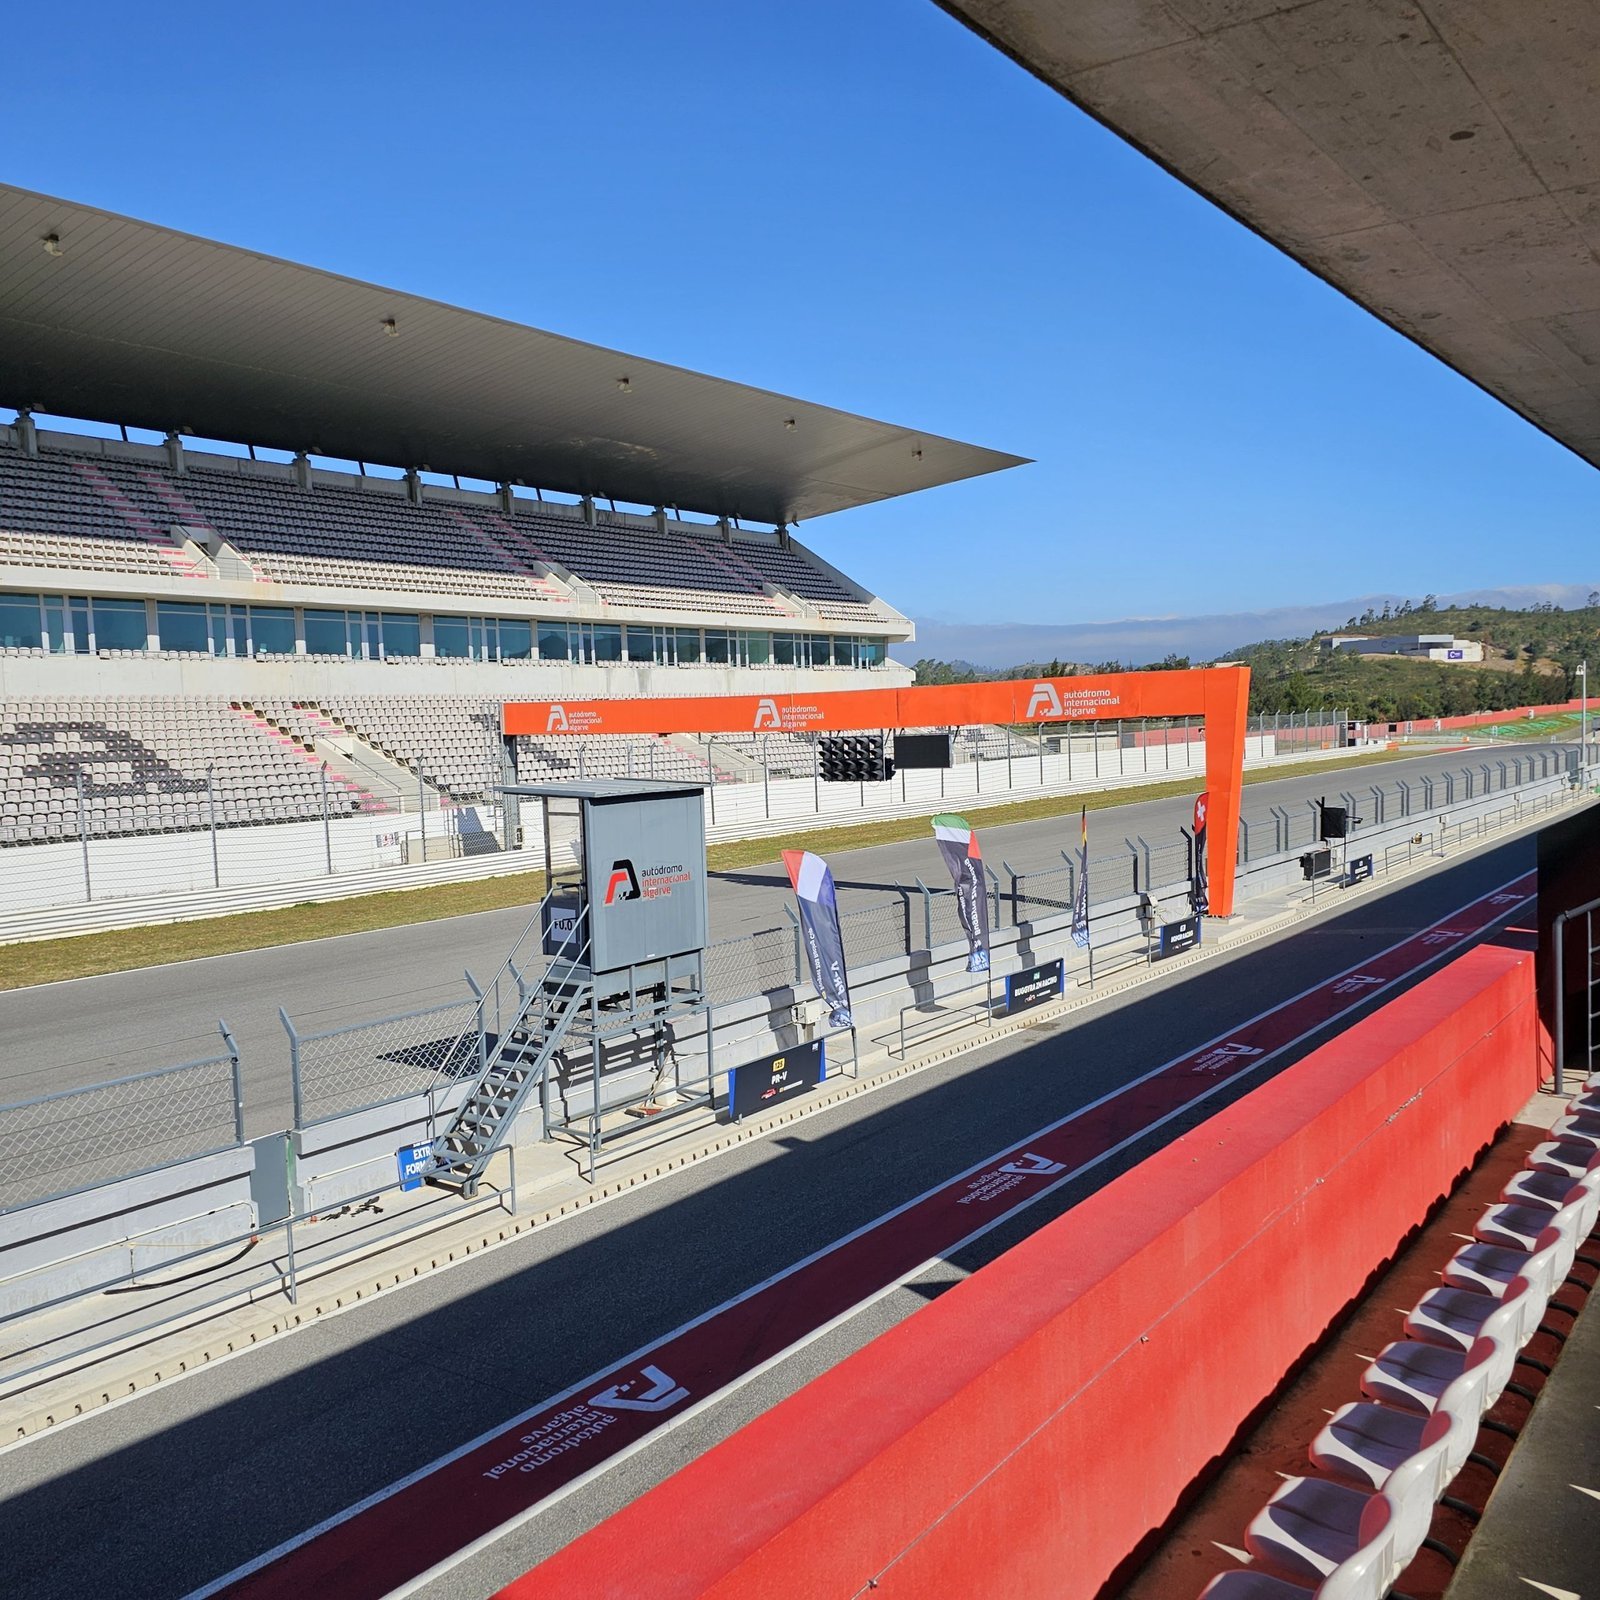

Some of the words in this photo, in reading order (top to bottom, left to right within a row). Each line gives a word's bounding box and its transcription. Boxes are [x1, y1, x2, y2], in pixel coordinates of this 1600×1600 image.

[1063, 689, 1111, 699] autódromo
[1064, 695, 1120, 707] internacional
[781, 712, 825, 720] internacional
[1064, 707, 1096, 717] algarve
[569, 716, 603, 725] internacional
[782, 721, 807, 729] algarve
[569, 724, 589, 733] algarve
[641, 864, 683, 877] autódromo
[642, 871, 691, 887] internacional
[642, 886, 671, 899] algarve
[771, 1071, 788, 1085] PR-V
[520, 1404, 588, 1444] algarve
[483, 1410, 602, 1480] internacional
[519, 1415, 618, 1473] autódromo
